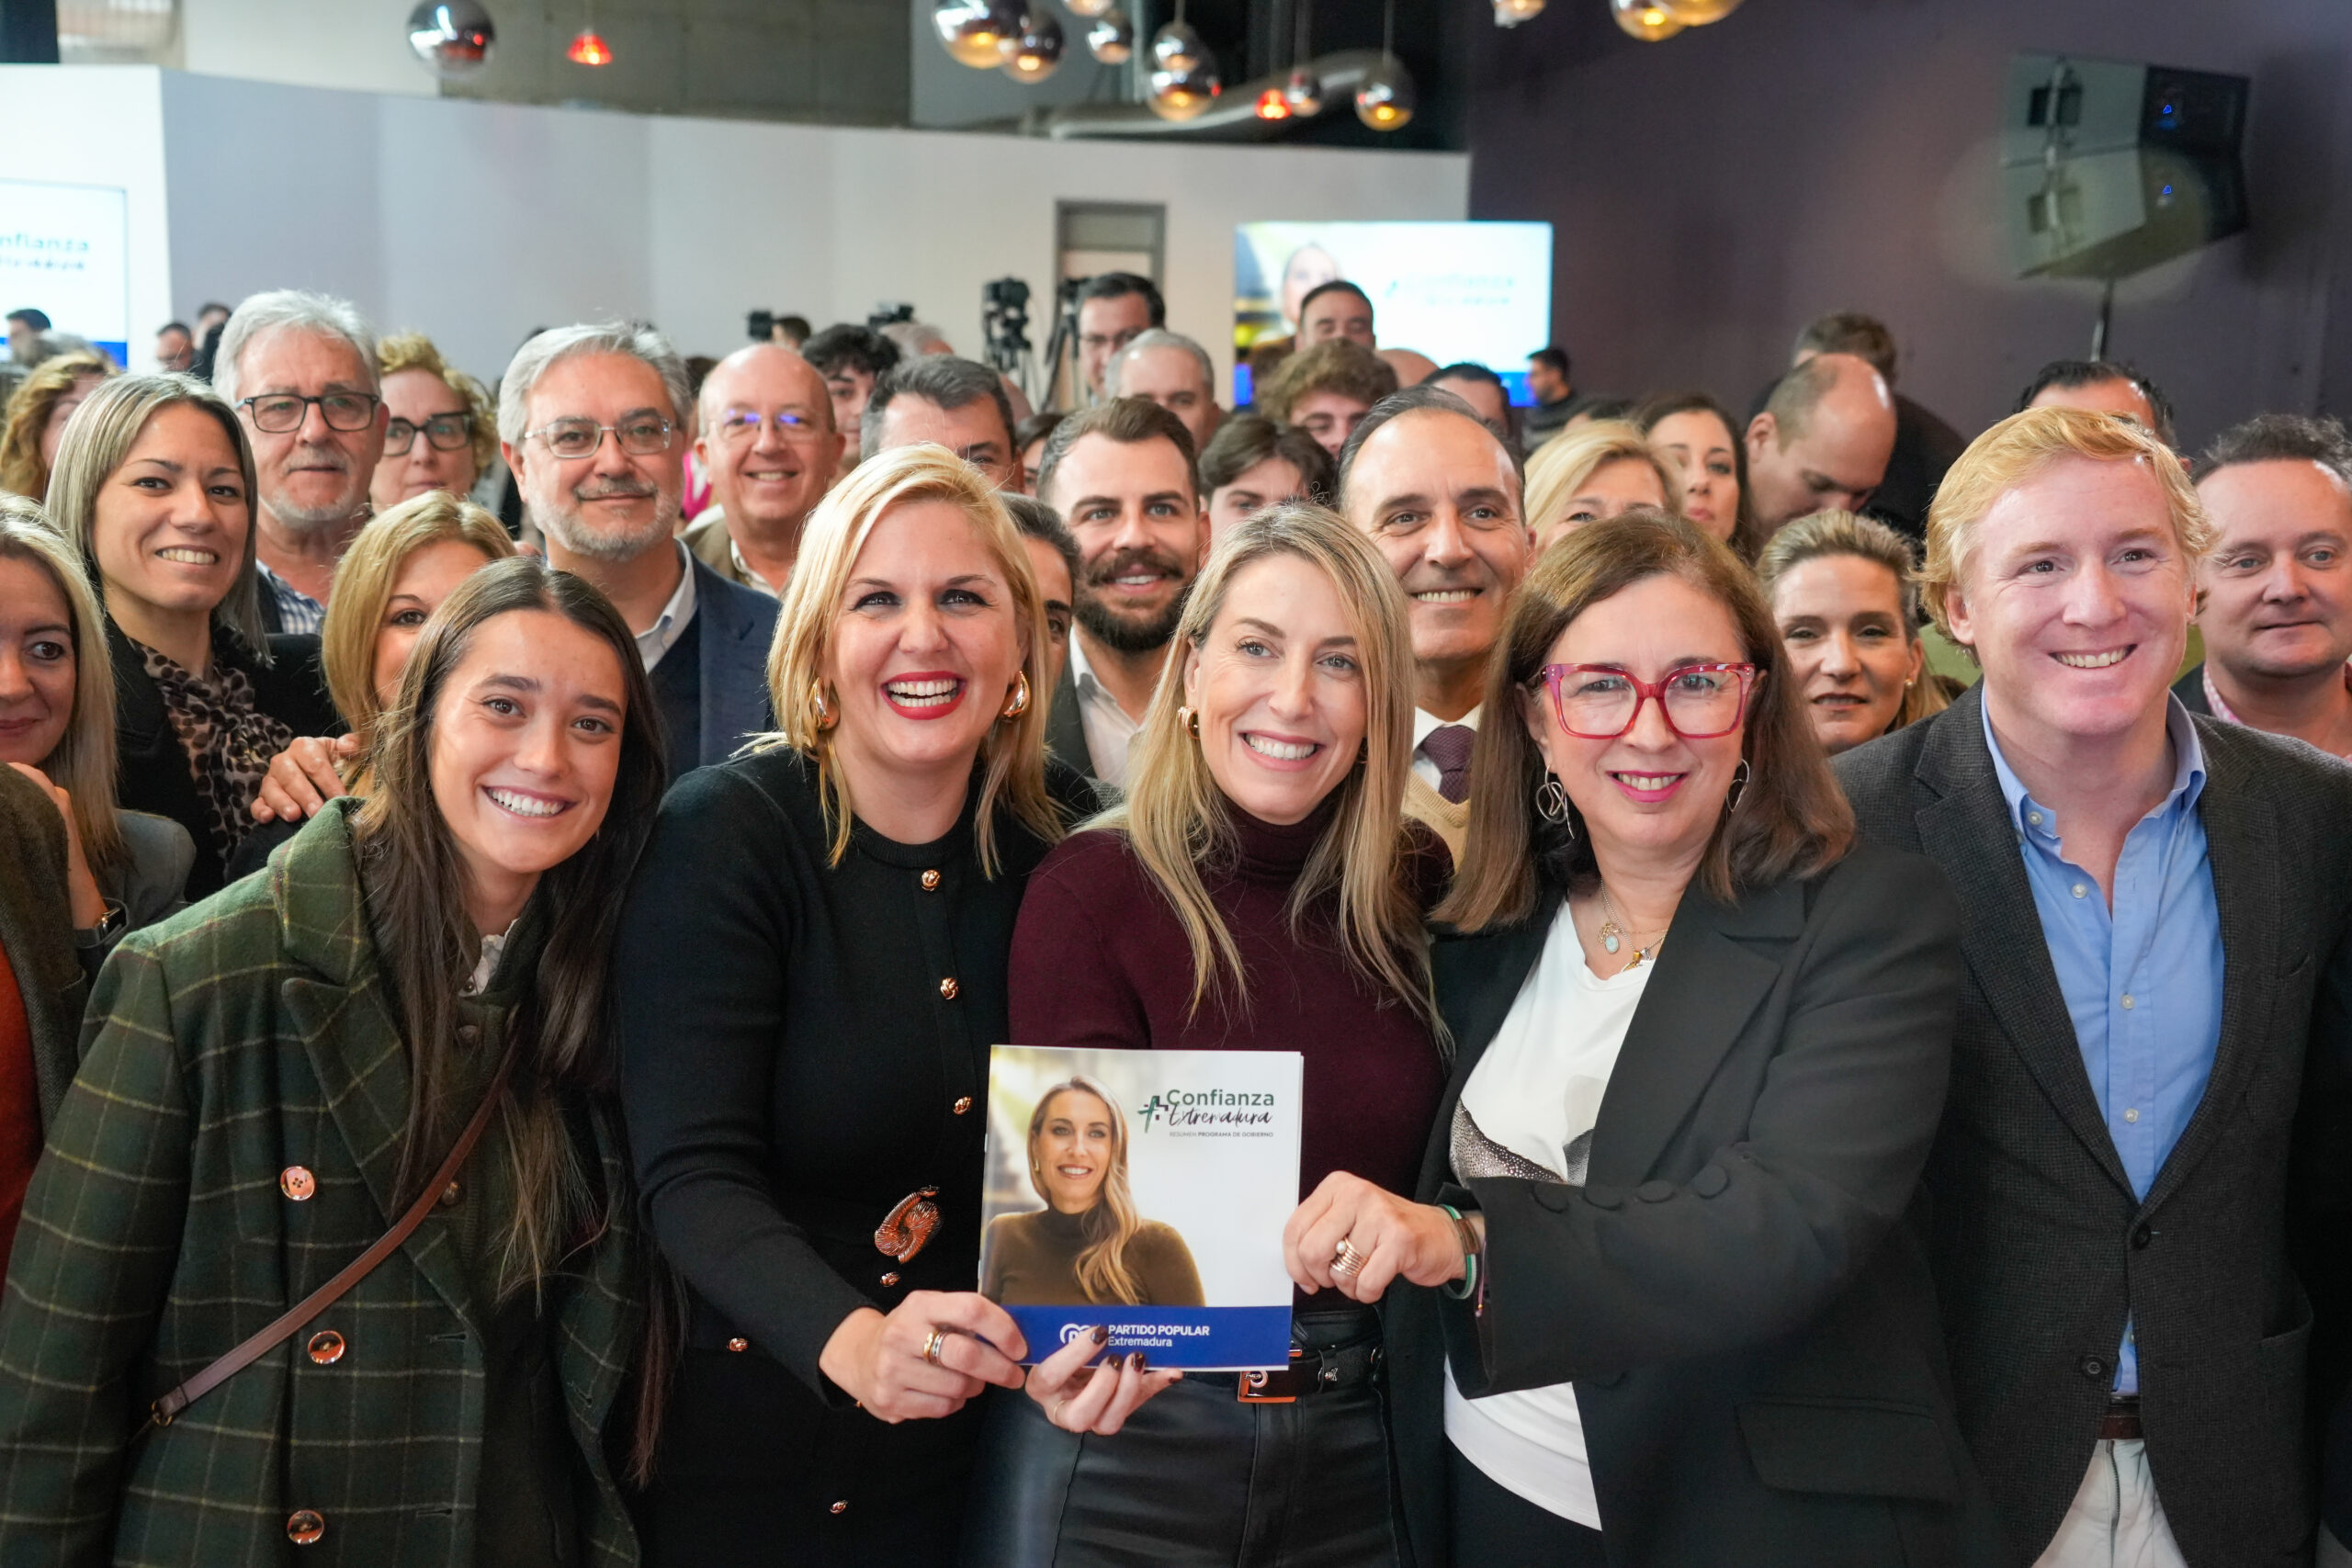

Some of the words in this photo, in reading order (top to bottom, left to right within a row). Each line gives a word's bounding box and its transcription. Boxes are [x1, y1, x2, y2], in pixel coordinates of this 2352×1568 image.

[1167, 1089, 1274, 1106] Confianza
[1169, 1104, 1272, 1127] Extremadura
[1108, 1325, 1158, 1335] PARTIDO
[1158, 1325, 1210, 1336] POPULAR
[1108, 1336, 1173, 1347] Extremadura
